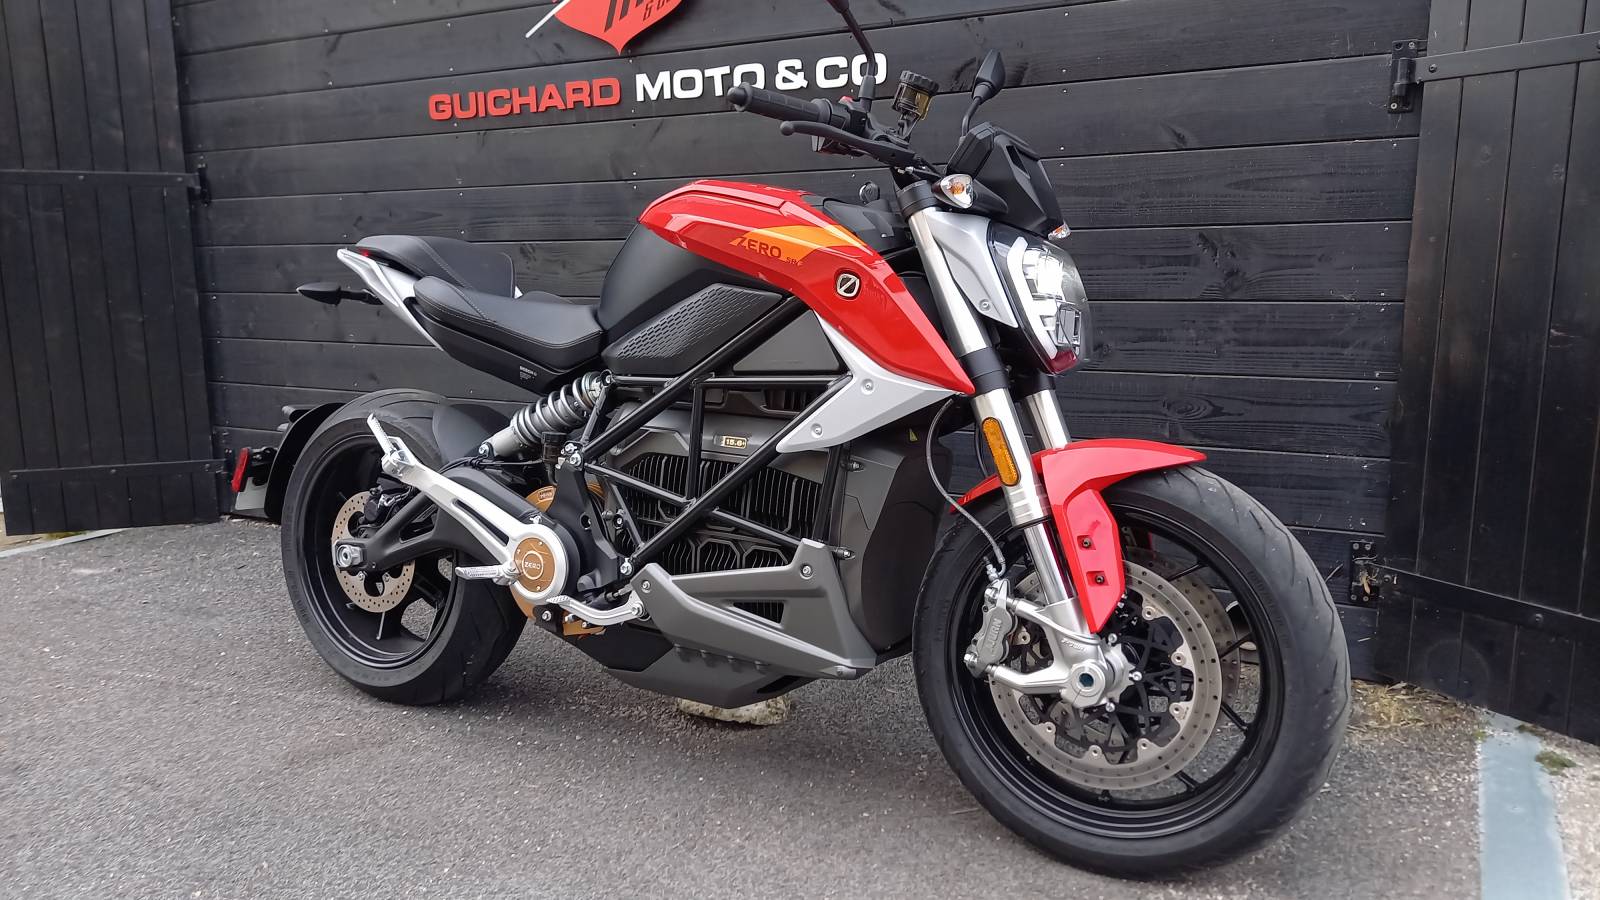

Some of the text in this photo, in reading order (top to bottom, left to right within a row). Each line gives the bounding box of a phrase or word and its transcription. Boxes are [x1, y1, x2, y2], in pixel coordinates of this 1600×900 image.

[428, 52, 887, 121] GUICHARD MOTO & CO
[728, 236, 782, 258] ZERO
[524, 561, 541, 570] ZERO
